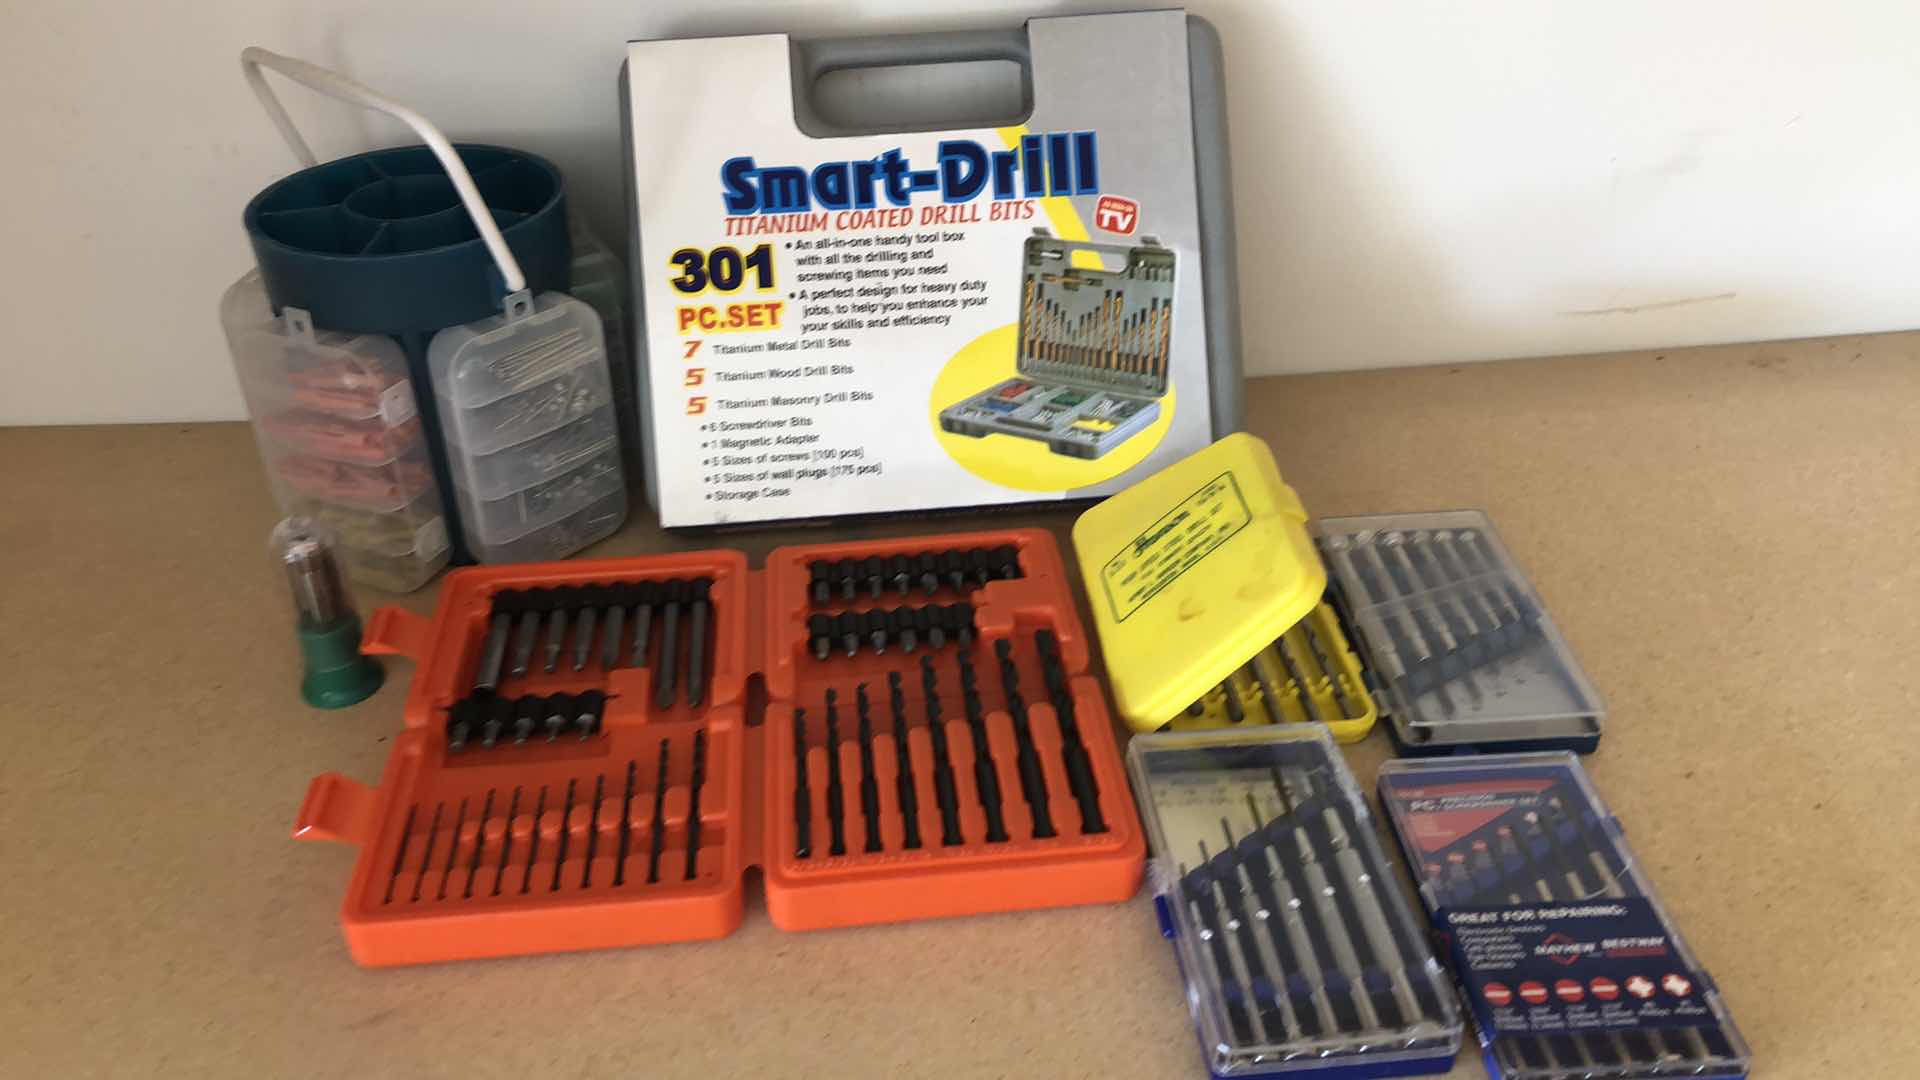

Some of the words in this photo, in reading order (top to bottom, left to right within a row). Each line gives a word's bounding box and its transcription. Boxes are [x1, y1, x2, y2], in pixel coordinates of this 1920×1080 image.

[721, 130, 1098, 215] Smart-Drill
[725, 213, 829, 236] TITANIUM
[836, 207, 912, 230] COATED
[920, 203, 981, 226] DRILL
[990, 200, 1035, 221] BITS
[1100, 210, 1134, 230] TV
[795, 238, 812, 250] An
[815, 237, 872, 249] all-in-one
[874, 236, 912, 250] handy
[915, 233, 940, 245] tool
[943, 231, 965, 242] box
[796, 254, 821, 266] with
[825, 253, 840, 264] all
[843, 252, 863, 263] the
[866, 250, 908, 264] drilling
[911, 249, 934, 260] and
[671, 244, 774, 293] 301
[798, 269, 853, 283] screwing
[856, 268, 889, 280] items
[893, 268, 914, 279] you
[918, 263, 948, 276] need
[800, 290, 808, 299] A
[811, 287, 854, 301] perfect
[857, 285, 898, 299] design
[900, 283, 917, 294] for
[921, 281, 957, 295] heavy
[960, 279, 987, 293] duty
[836, 304, 848, 314] to
[851, 301, 881, 316] help
[881, 303, 903, 315] you
[907, 298, 957, 310] enhance
[960, 296, 989, 309] your
[680, 304, 781, 330] PC.SET
[800, 321, 829, 335] your
[831, 318, 864, 330] skills
[867, 316, 890, 327] and
[892, 313, 952, 328] efficiency
[683, 341, 703, 359] 7
[713, 343, 765, 355] Titanium
[767, 340, 799, 351] Metal
[801, 338, 826, 350] Drill
[828, 337, 852, 348] Bits
[685, 368, 706, 386] 5
[715, 371, 766, 382] Titanium
[767, 367, 801, 379] Wood
[804, 366, 829, 376] Drill
[831, 364, 854, 375] Bits
[686, 396, 708, 414] 5
[717, 398, 768, 409] Titanium
[770, 395, 821, 407] Masonry
[824, 392, 848, 403] Drill
[850, 390, 874, 401] Bits
[719, 419, 787, 432] Screwdriver
[790, 416, 813, 427] Bits
[721, 437, 772, 449] Magnetic
[774, 433, 820, 446] Adapter
[722, 455, 753, 466] Sizes
[756, 453, 768, 464] of
[770, 452, 810, 462] screws
[723, 472, 754, 483] Sizes
[757, 470, 769, 481] of
[771, 469, 794, 479] wall
[796, 467, 828, 480] plugs
[714, 489, 759, 501] Storage
[761, 487, 791, 498] Case
[1448, 912, 1498, 924] GREAT
[1502, 909, 1537, 922] FOR
